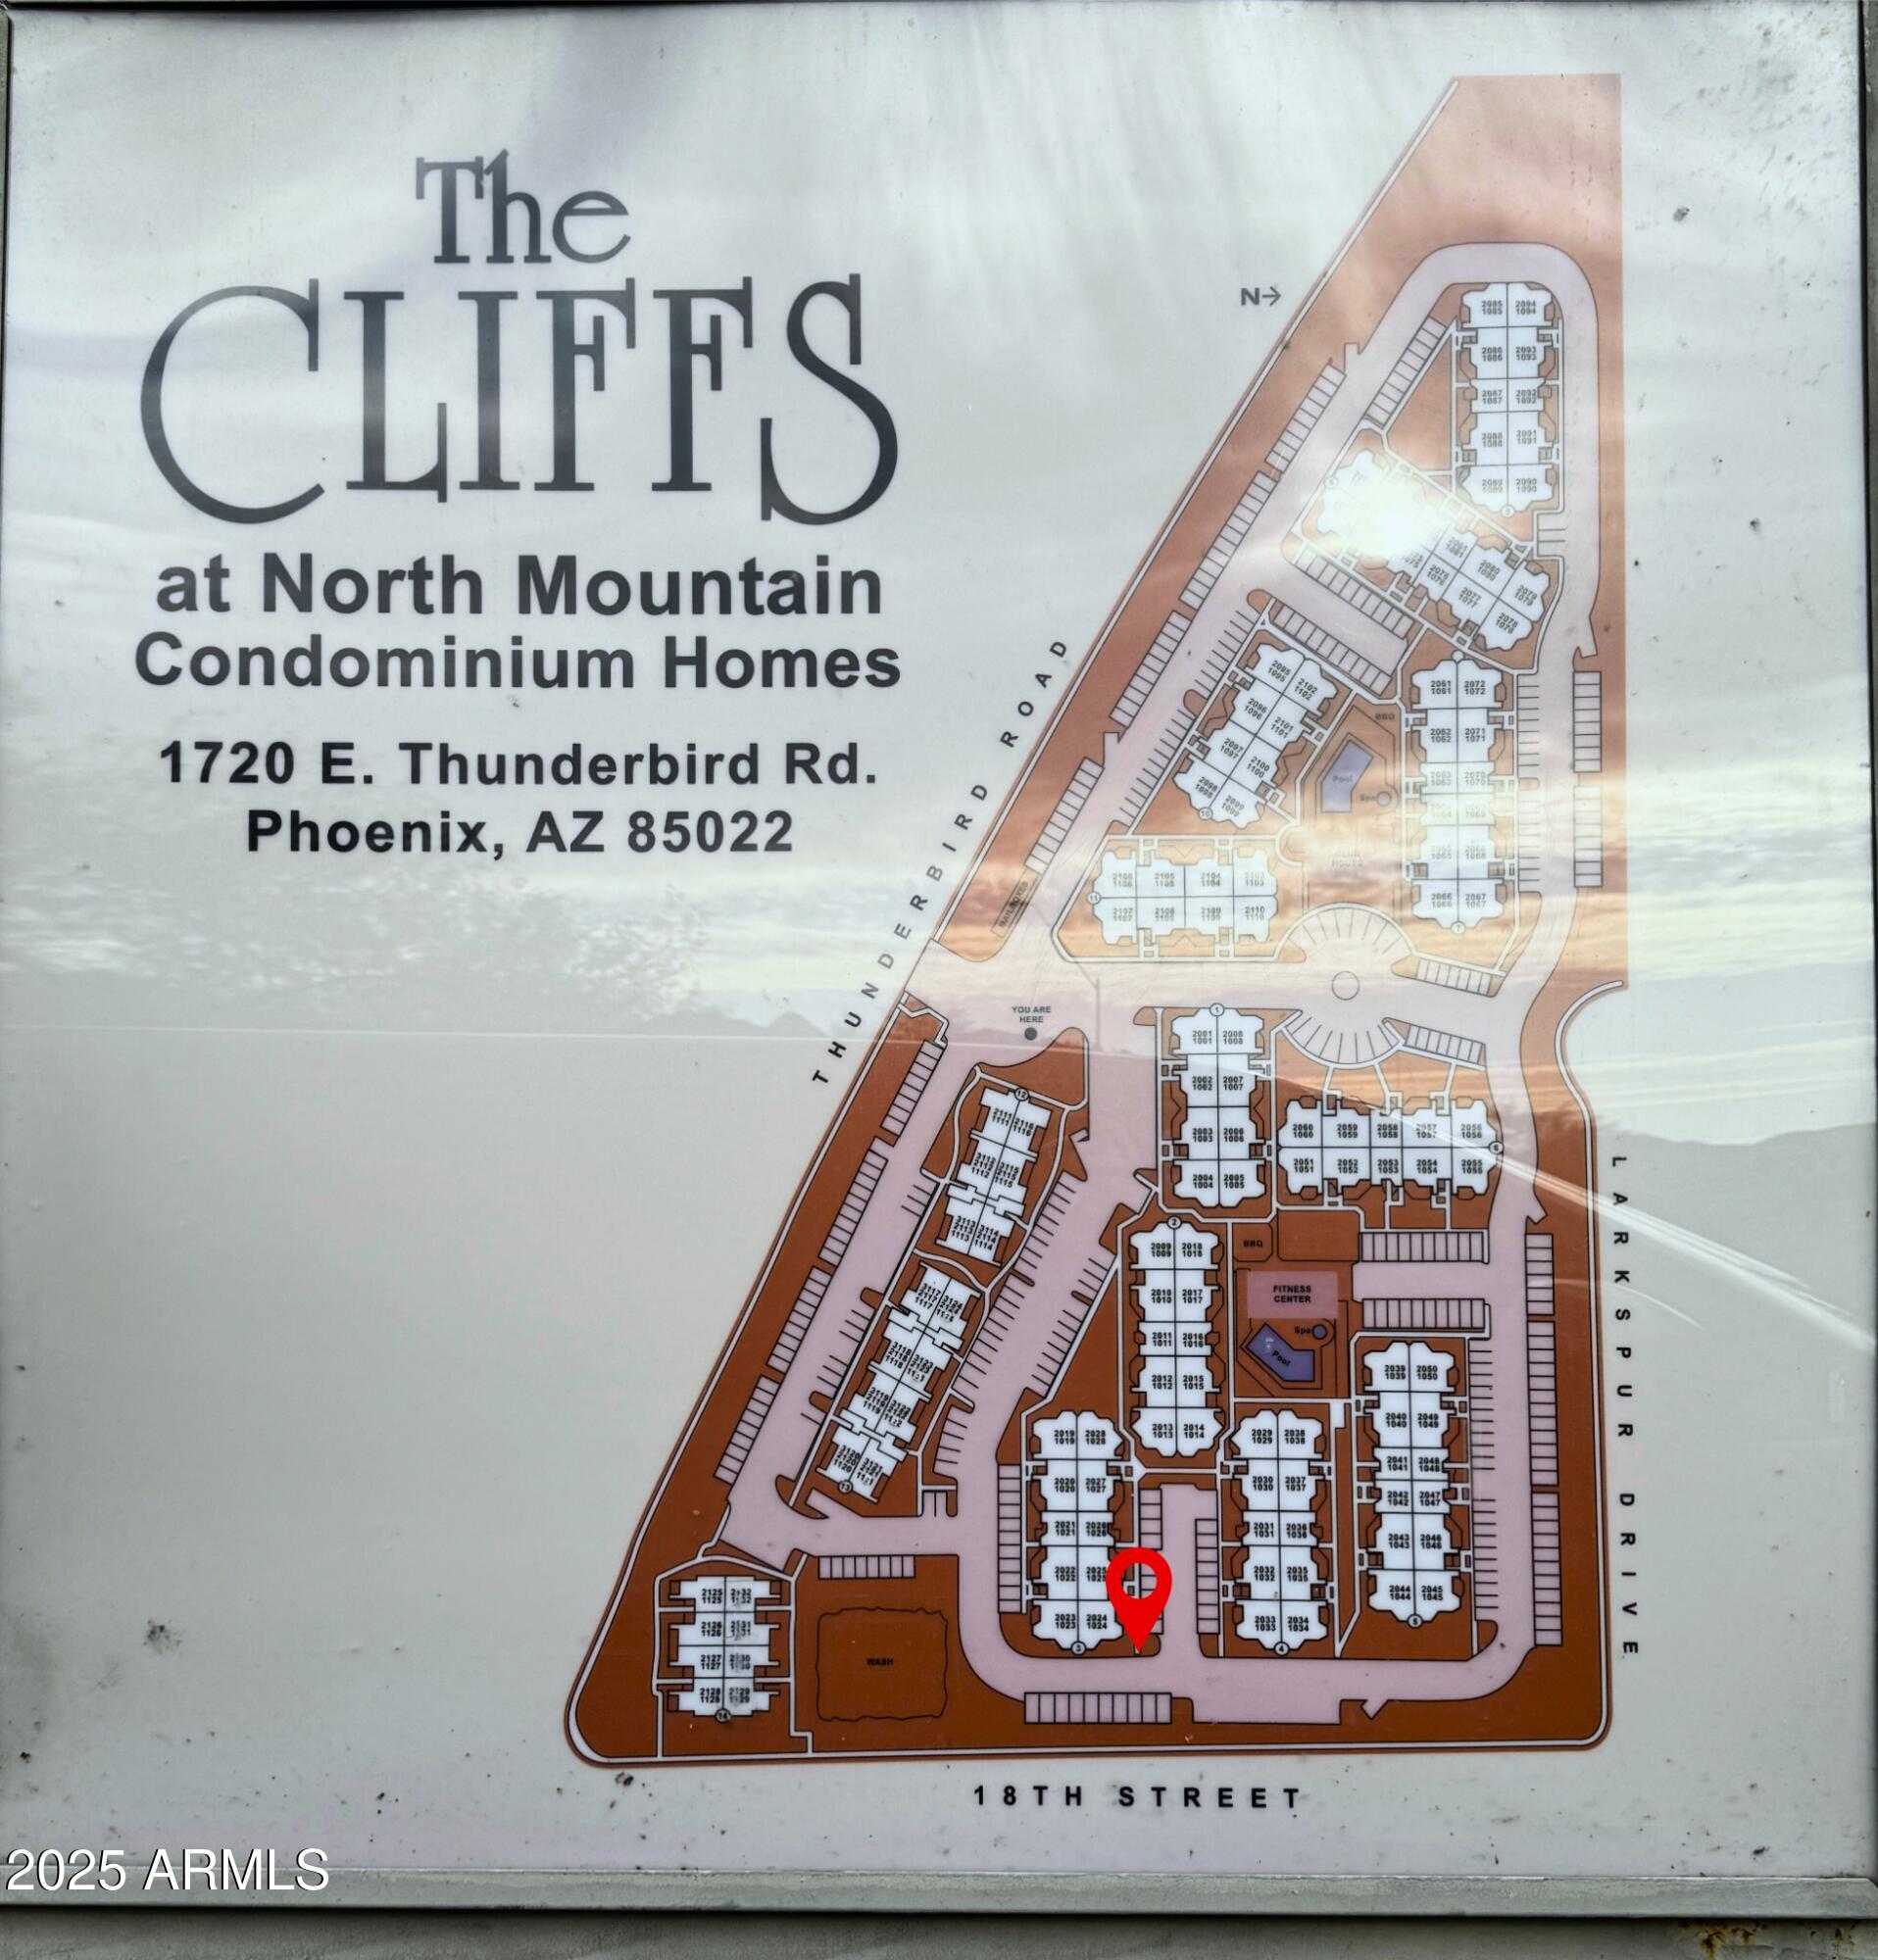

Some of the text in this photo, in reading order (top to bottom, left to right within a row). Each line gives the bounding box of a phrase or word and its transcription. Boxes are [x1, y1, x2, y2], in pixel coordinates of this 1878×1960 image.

[417, 149, 630, 265] The
[1241, 288, 1260, 306] N
[140, 273, 898, 525] CLIFFS
[157, 553, 880, 615] at North Mountain
[135, 631, 900, 689] Condominium Homes
[161, 740, 875, 785] 1720 E. Thunderbird Rd.
[248, 809, 792, 861] Phoenix, AZ 85022
[813, 641, 1066, 1085] THUNDERBIRD ROAD
[1378, 1159, 1399, 1167] 2053
[1273, 1350, 1291, 1367] Pool
[1612, 1156, 1639, 1653] LARKSPUR DRIVE
[1085, 1478, 1106, 1486] 2027
[1285, 1476, 1305, 1484] 2037
[1388, 1498, 1409, 1506] 1042
[1055, 1521, 1076, 1529] 2021
[1253, 1522, 1274, 1530] 2031
[1055, 1566, 1076, 1574] 2022
[1254, 1566, 1275, 1574] 2032
[1255, 1573, 1275, 1581] 1032
[702, 1596, 723, 1604] 1125
[1086, 1614, 1107, 1622] 2024
[1255, 1616, 1276, 1624] 2033
[1256, 1623, 1276, 1631] 1033
[701, 1654, 722, 1662] 2127
[974, 1785, 1299, 1809] 18TH STREET
